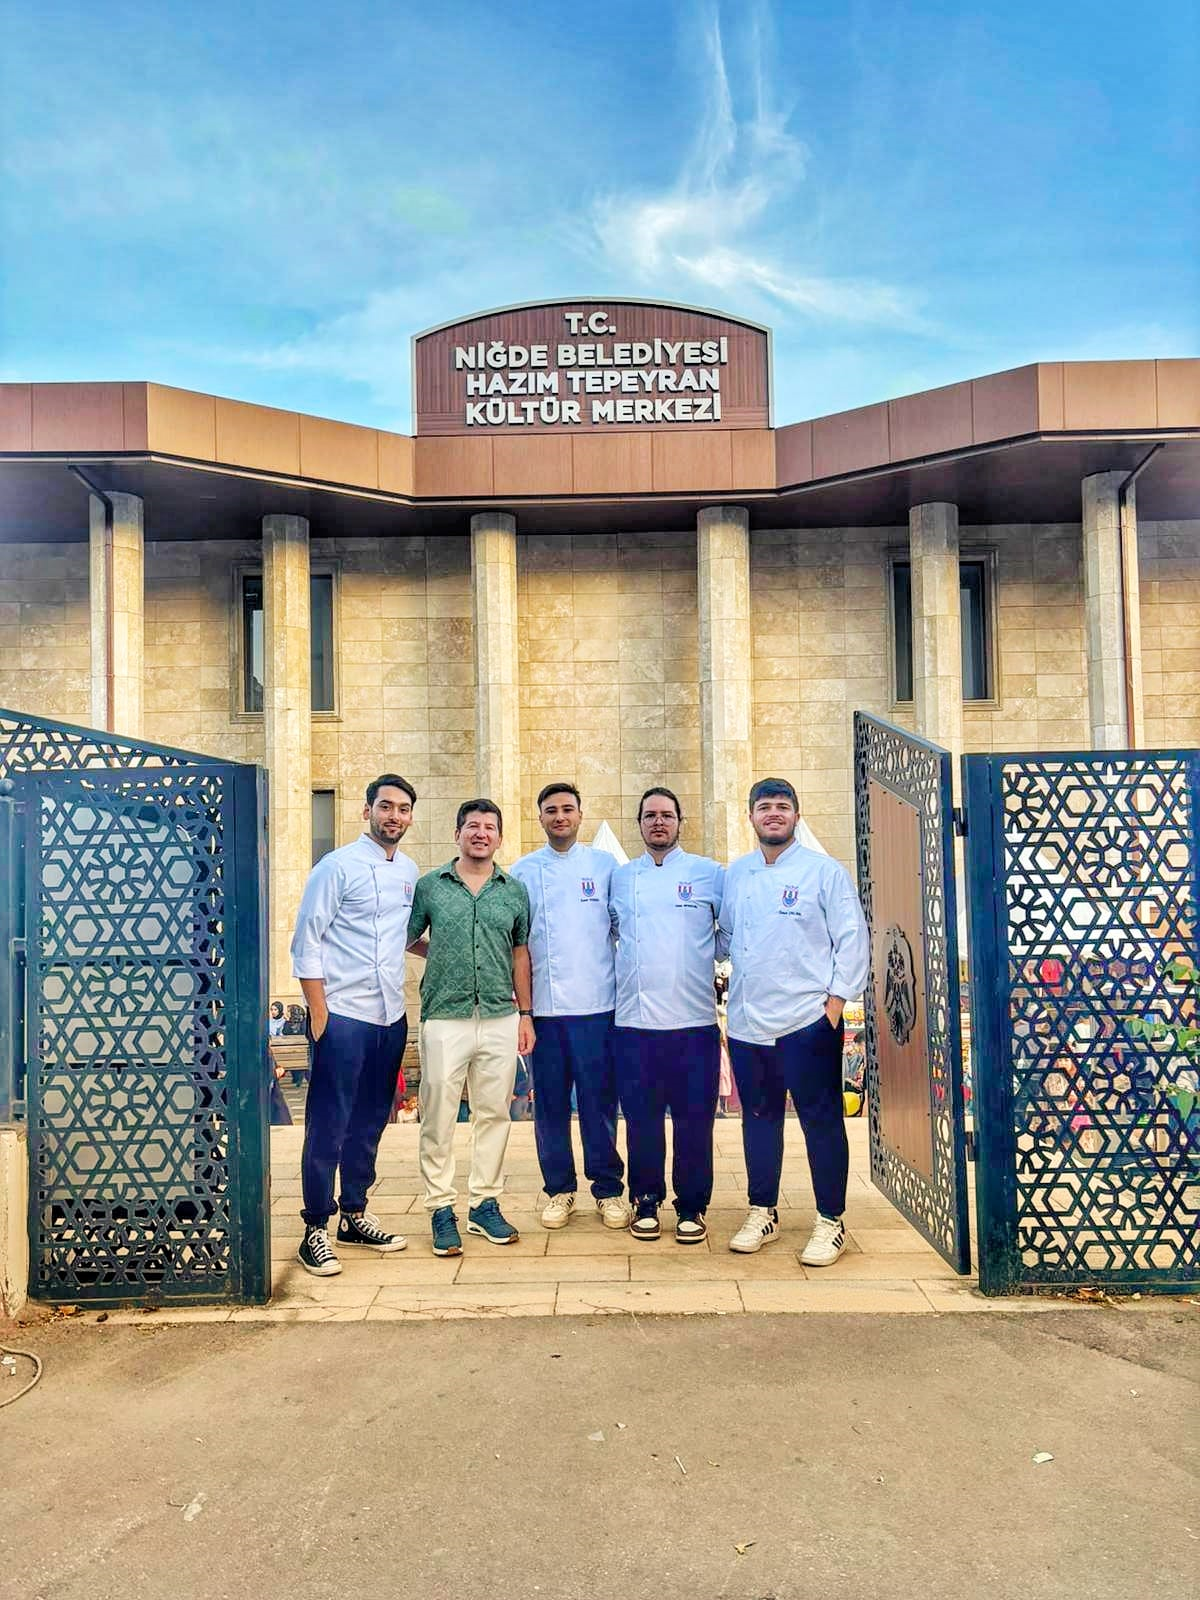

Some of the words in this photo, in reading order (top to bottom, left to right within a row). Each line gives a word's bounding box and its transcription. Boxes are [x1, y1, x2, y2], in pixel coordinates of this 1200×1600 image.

[565, 312, 616, 334] T.C.
[455, 341, 548, 368] NİĞDE
[557, 337, 728, 365] BELEDİYESİ
[466, 372, 559, 395] HAZIM
[567, 368, 719, 393] TEPEYRAN
[466, 397, 581, 424] KÜLTÜR
[592, 393, 721, 422] MERKEZİ
